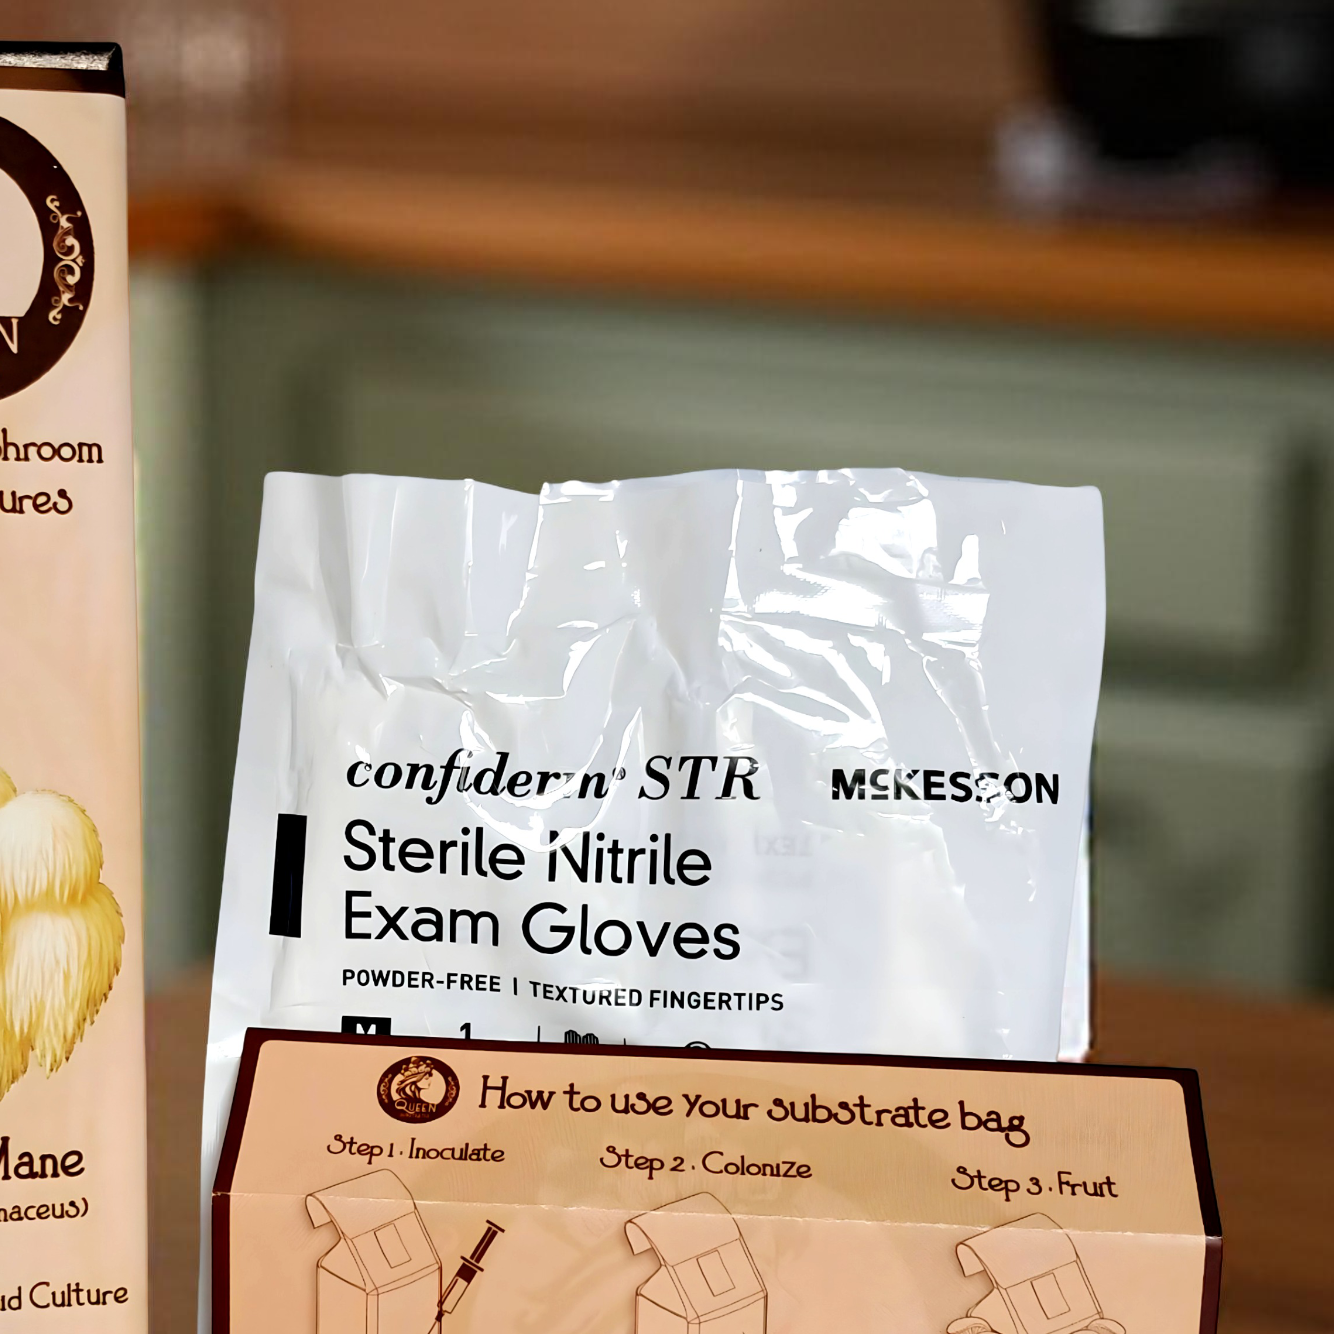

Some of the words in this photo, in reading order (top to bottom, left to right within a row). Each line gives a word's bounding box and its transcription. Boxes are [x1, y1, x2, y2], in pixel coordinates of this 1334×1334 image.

[638, 755, 761, 801] STR
[343, 818, 526, 881] Sterile
[547, 830, 712, 886] Nitrile
[344, 890, 499, 947] Exam
[521, 901, 741, 961] Gloves
[342, 968, 501, 993] POWDER-FREE
[528, 980, 642, 1008] TEXTURED
[649, 989, 784, 1012] FINGERTIPS
[394, 1099, 437, 1114] QUEEN
[478, 1074, 557, 1111] How
[562, 1082, 602, 1113] to
[609, 1091, 674, 1117] use
[681, 1093, 760, 1121] your
[766, 1092, 952, 1130] substrate
[957, 1099, 1031, 1149] bag
[326, 1133, 384, 1166] Step
[407, 1136, 506, 1163] Inoculate
[599, 1144, 666, 1181] Step
[701, 1150, 813, 1179] Colonize
[950, 1165, 1021, 1203] Step
[1056, 1170, 1119, 1199] Fruit
[28, 1281, 129, 1310] Culture
